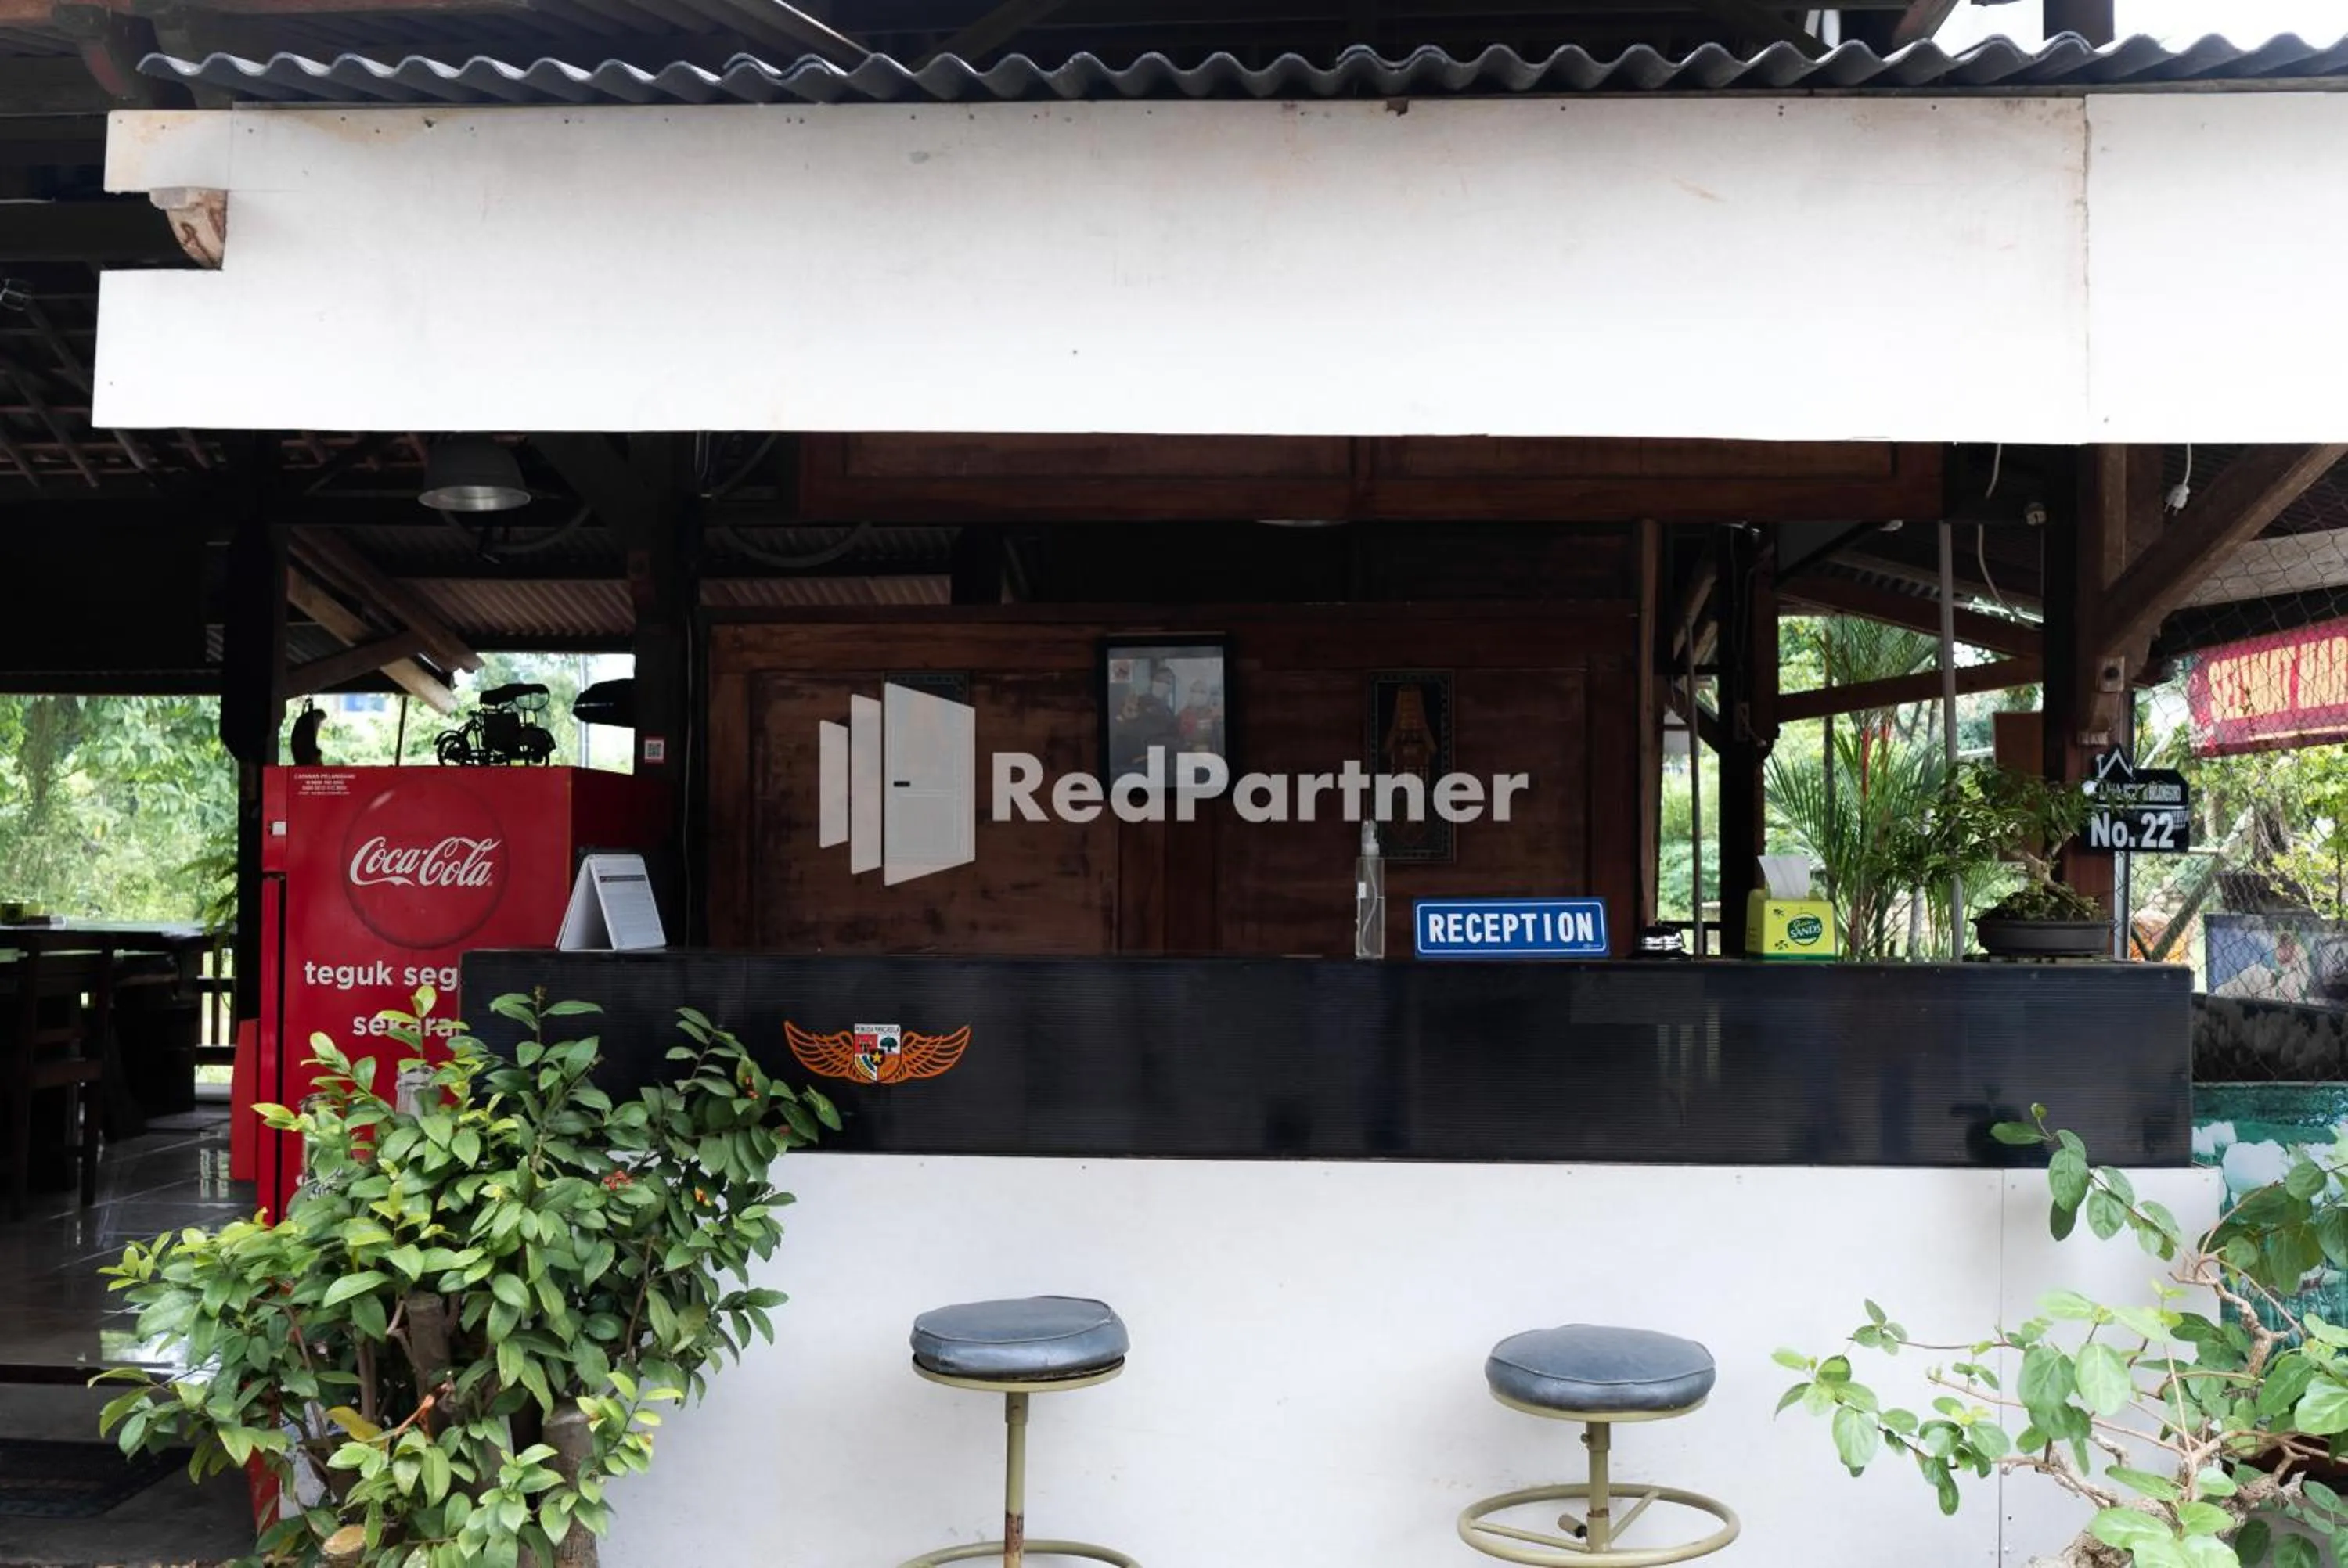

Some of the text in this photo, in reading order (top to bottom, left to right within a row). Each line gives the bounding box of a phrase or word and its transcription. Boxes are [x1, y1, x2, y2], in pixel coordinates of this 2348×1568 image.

[2091, 811, 2136, 847] No.
[2141, 812, 2175, 847] 22
[350, 836, 502, 886] Coca-Cola
[1428, 912, 1594, 943] RECEPTION
[304, 960, 459, 991] teguk seg
